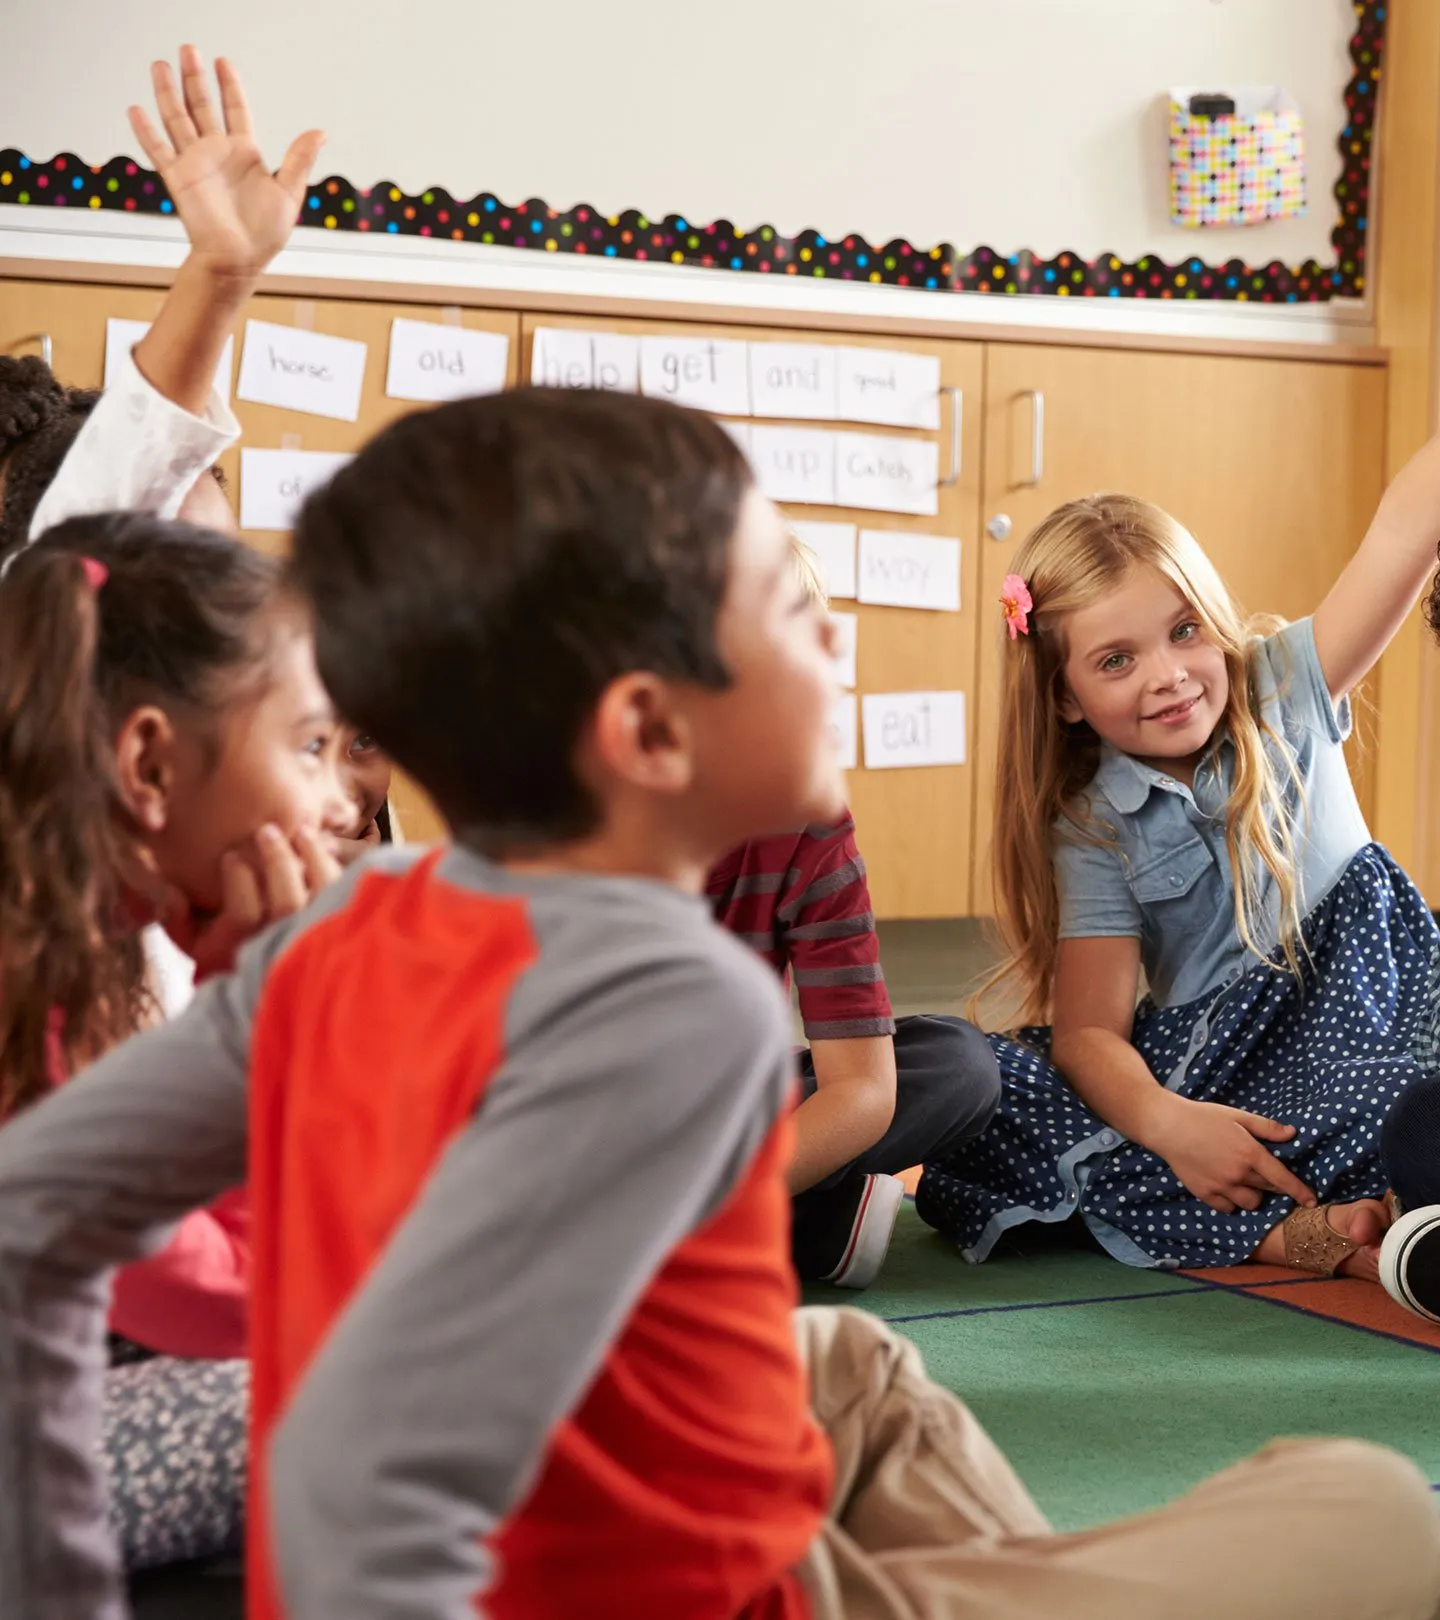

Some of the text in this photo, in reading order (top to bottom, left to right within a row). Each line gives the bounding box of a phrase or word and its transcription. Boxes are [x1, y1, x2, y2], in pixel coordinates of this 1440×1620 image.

[267, 344, 334, 382] horse
[661, 341, 720, 394] get
[766, 357, 821, 392] and
[773, 447, 820, 481] up
[880, 698, 932, 752] eat
